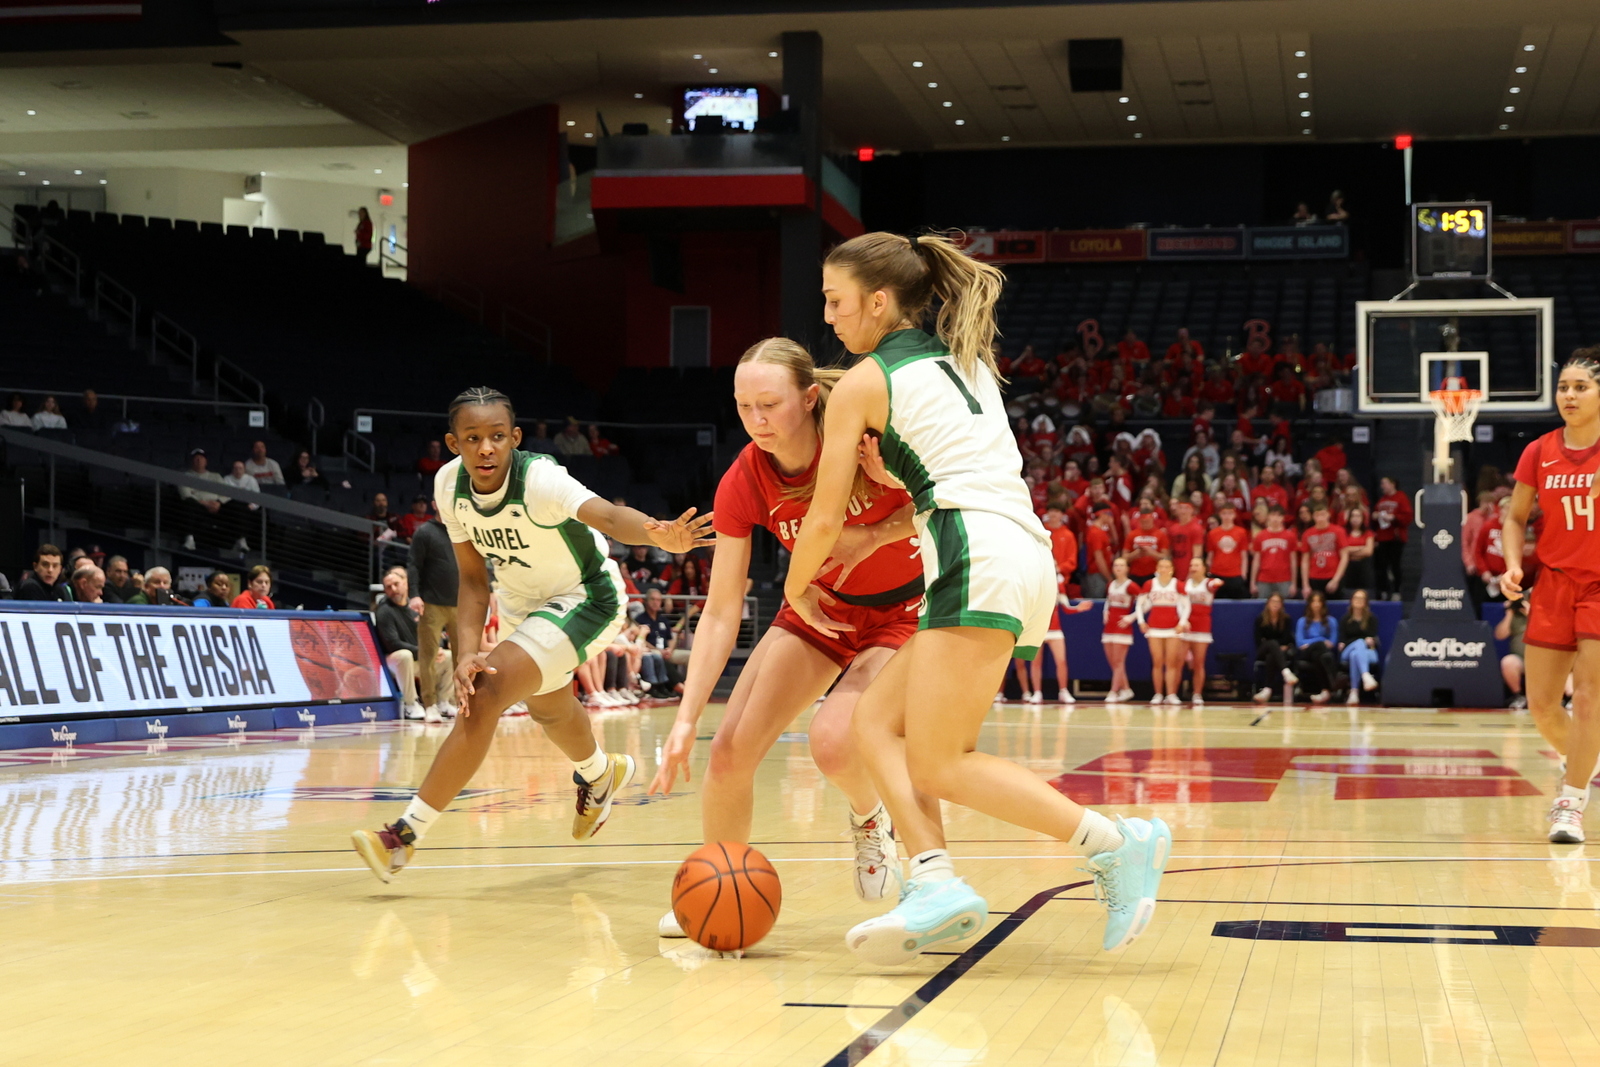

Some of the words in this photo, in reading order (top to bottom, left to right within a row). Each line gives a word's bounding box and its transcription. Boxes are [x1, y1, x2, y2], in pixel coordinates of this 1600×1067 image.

[1441, 209, 1483, 233] 1:57
[1069, 238, 1123, 253] LOYOLA
[1297, 234, 1342, 249] ISLAND
[1076, 318, 1104, 351] B
[1243, 318, 1272, 352] B
[934, 360, 984, 415] 1
[1545, 473, 1595, 490] BELLEV
[778, 493, 874, 541] BEUE
[1561, 495, 1595, 531] 14
[1422, 587, 1465, 599] Premier
[1425, 598, 1463, 610] Health
[1404, 637, 1486, 660] altafiber
[55, 622, 104, 703] OF
[105, 623, 178, 700] THE
[172, 624, 276, 698] OHSAA
